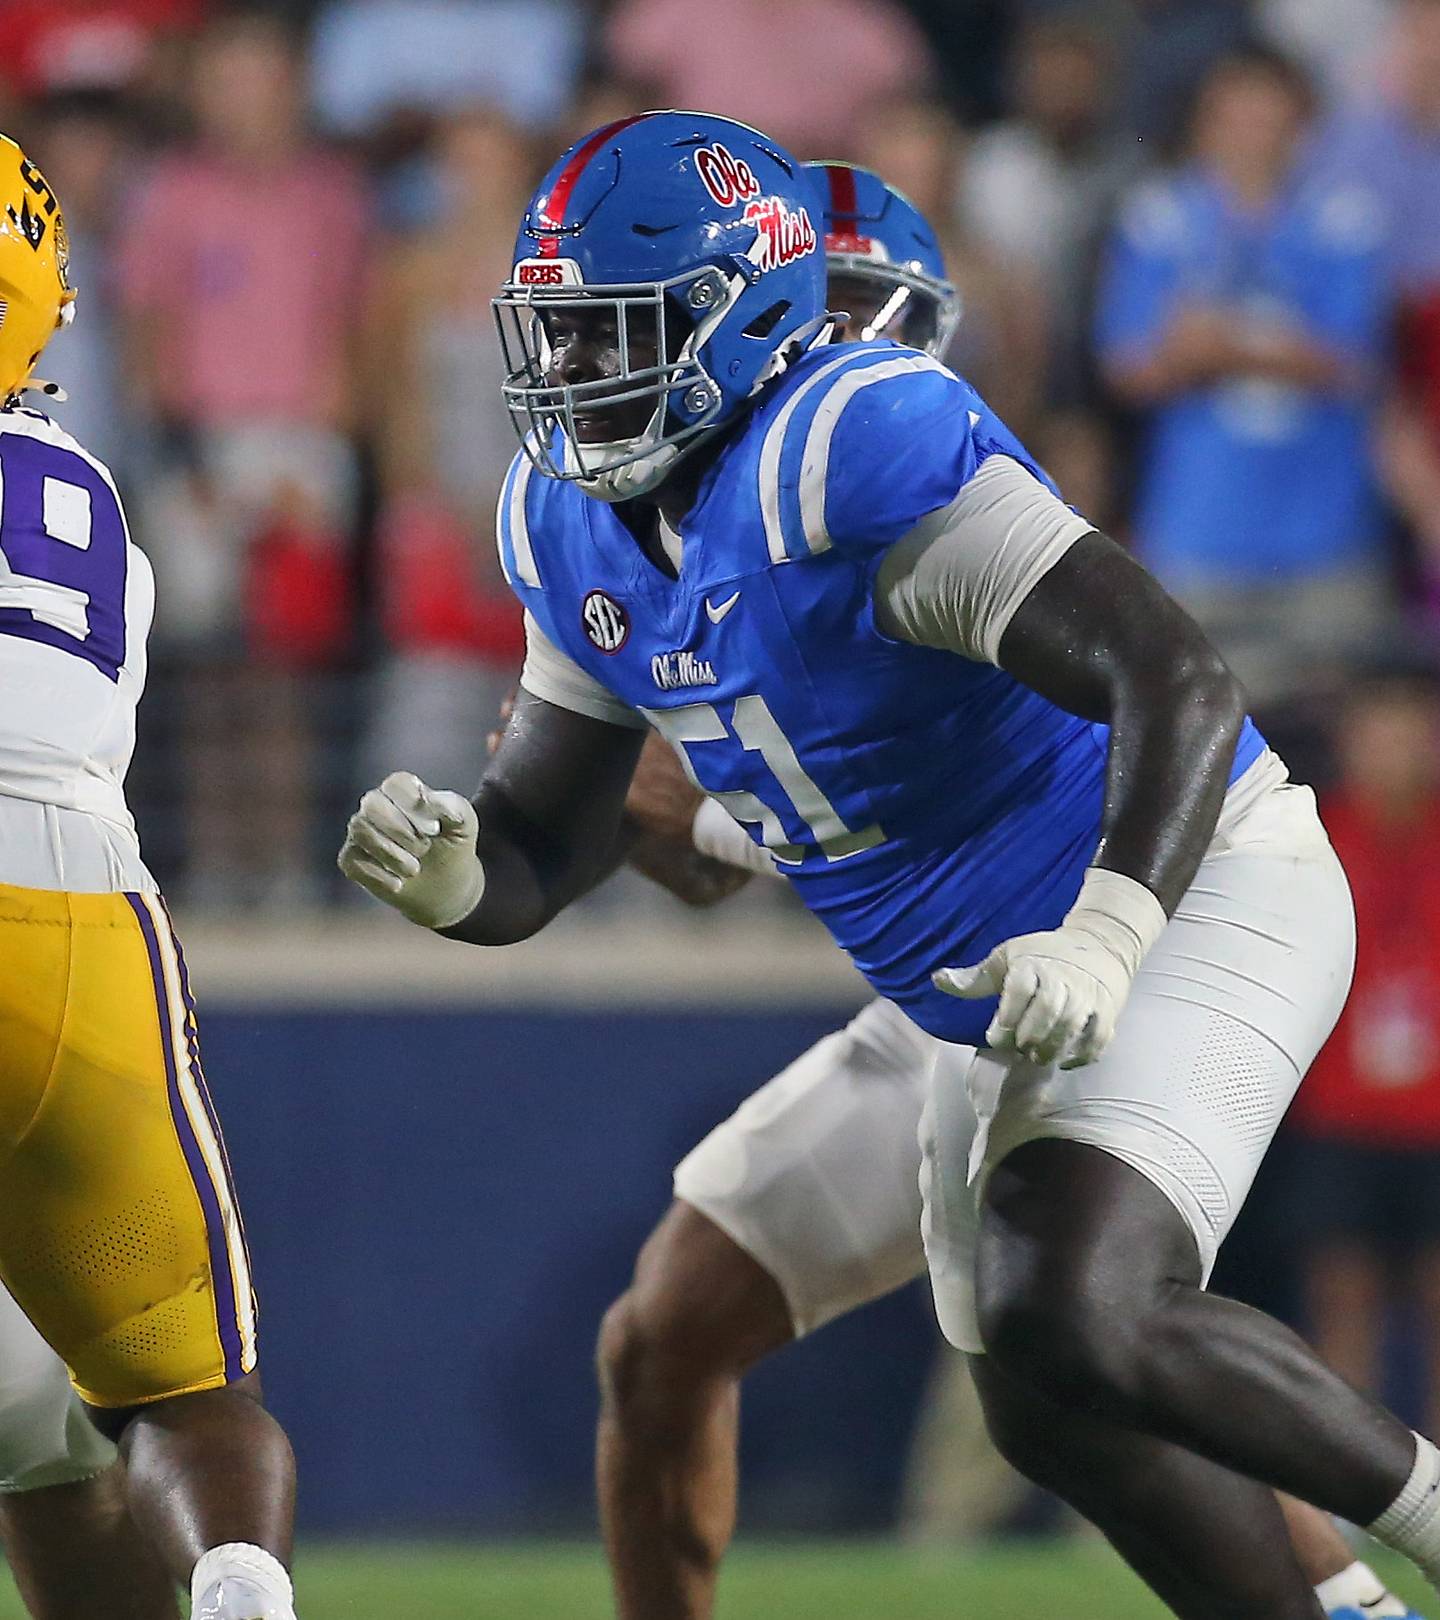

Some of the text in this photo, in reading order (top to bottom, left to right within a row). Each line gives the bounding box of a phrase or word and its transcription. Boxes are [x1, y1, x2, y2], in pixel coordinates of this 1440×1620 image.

[694, 143, 760, 207] Ole
[743, 195, 817, 273] Miss
[583, 593, 627, 651] SEC
[651, 652, 718, 691] Ole Miss
[636, 694, 888, 865] 51
